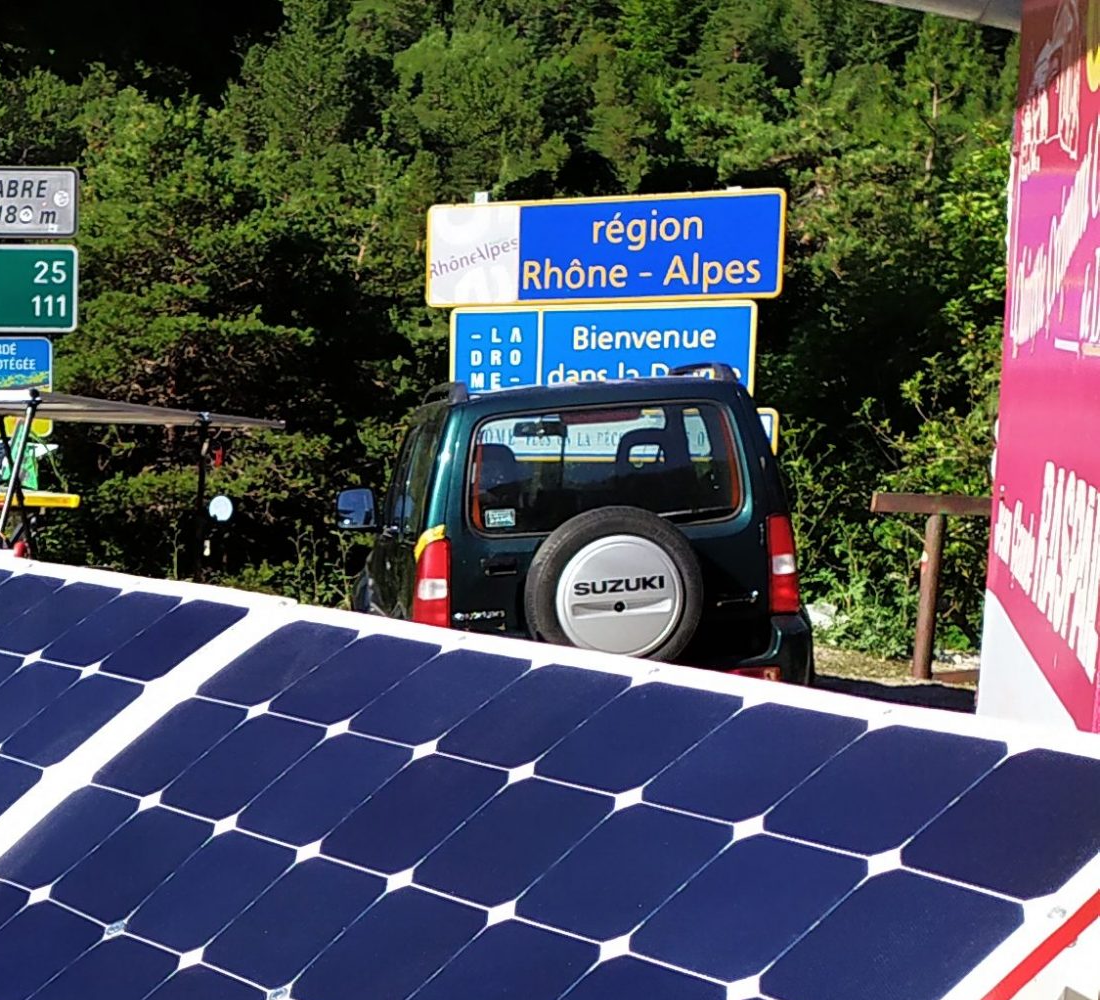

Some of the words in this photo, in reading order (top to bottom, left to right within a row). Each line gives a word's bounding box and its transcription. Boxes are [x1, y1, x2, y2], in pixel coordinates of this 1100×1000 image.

[39, 210, 56, 224] m
[591, 209, 703, 251] région
[33, 260, 67, 284] 25
[522, 257, 628, 290] Rhône
[663, 252, 762, 293] Alpes
[31, 294, 66, 317] 111
[573, 326, 717, 351] Bienvenue
[547, 362, 607, 385] dans
[574, 575, 665, 597] SUZUKI
